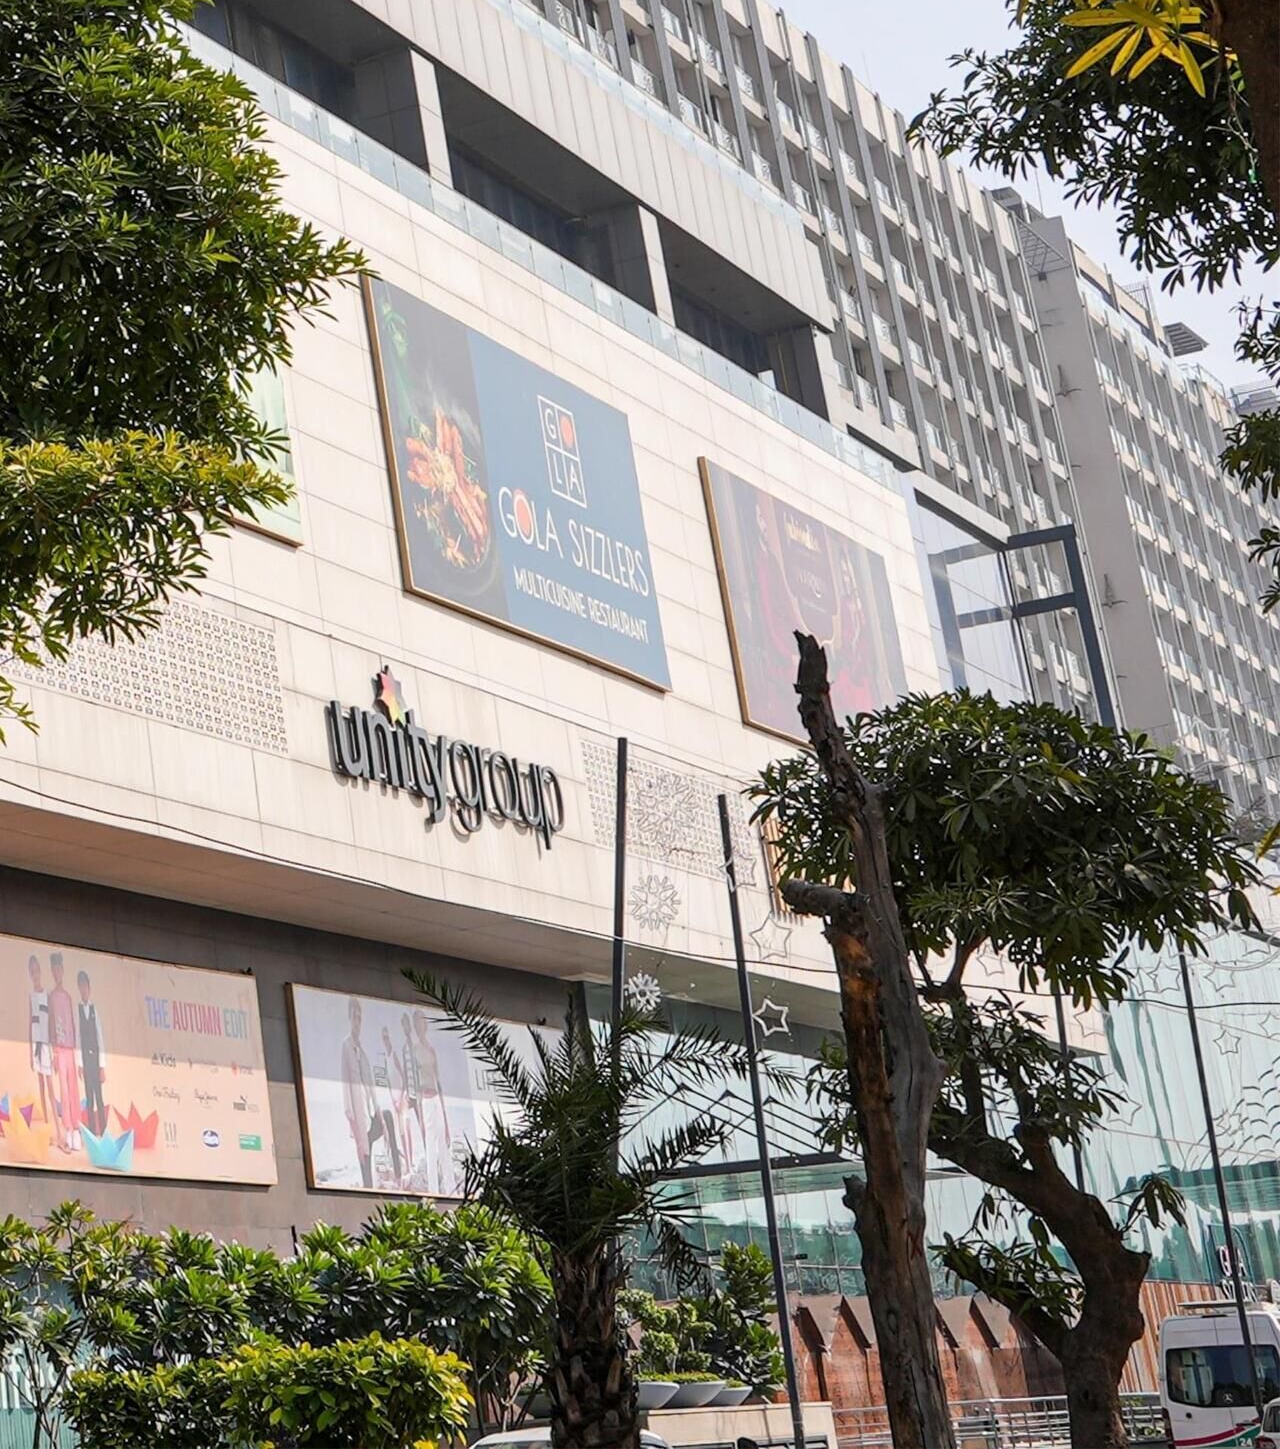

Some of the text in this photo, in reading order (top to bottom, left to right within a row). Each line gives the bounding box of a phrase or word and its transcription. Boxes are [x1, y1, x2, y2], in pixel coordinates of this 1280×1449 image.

[497, 485, 650, 598] GOLA SIZZLERS
[513, 565, 650, 646] MULTICUISINE RESTAURANT
[144, 995, 248, 1041] THE AUTUMN EDIT
